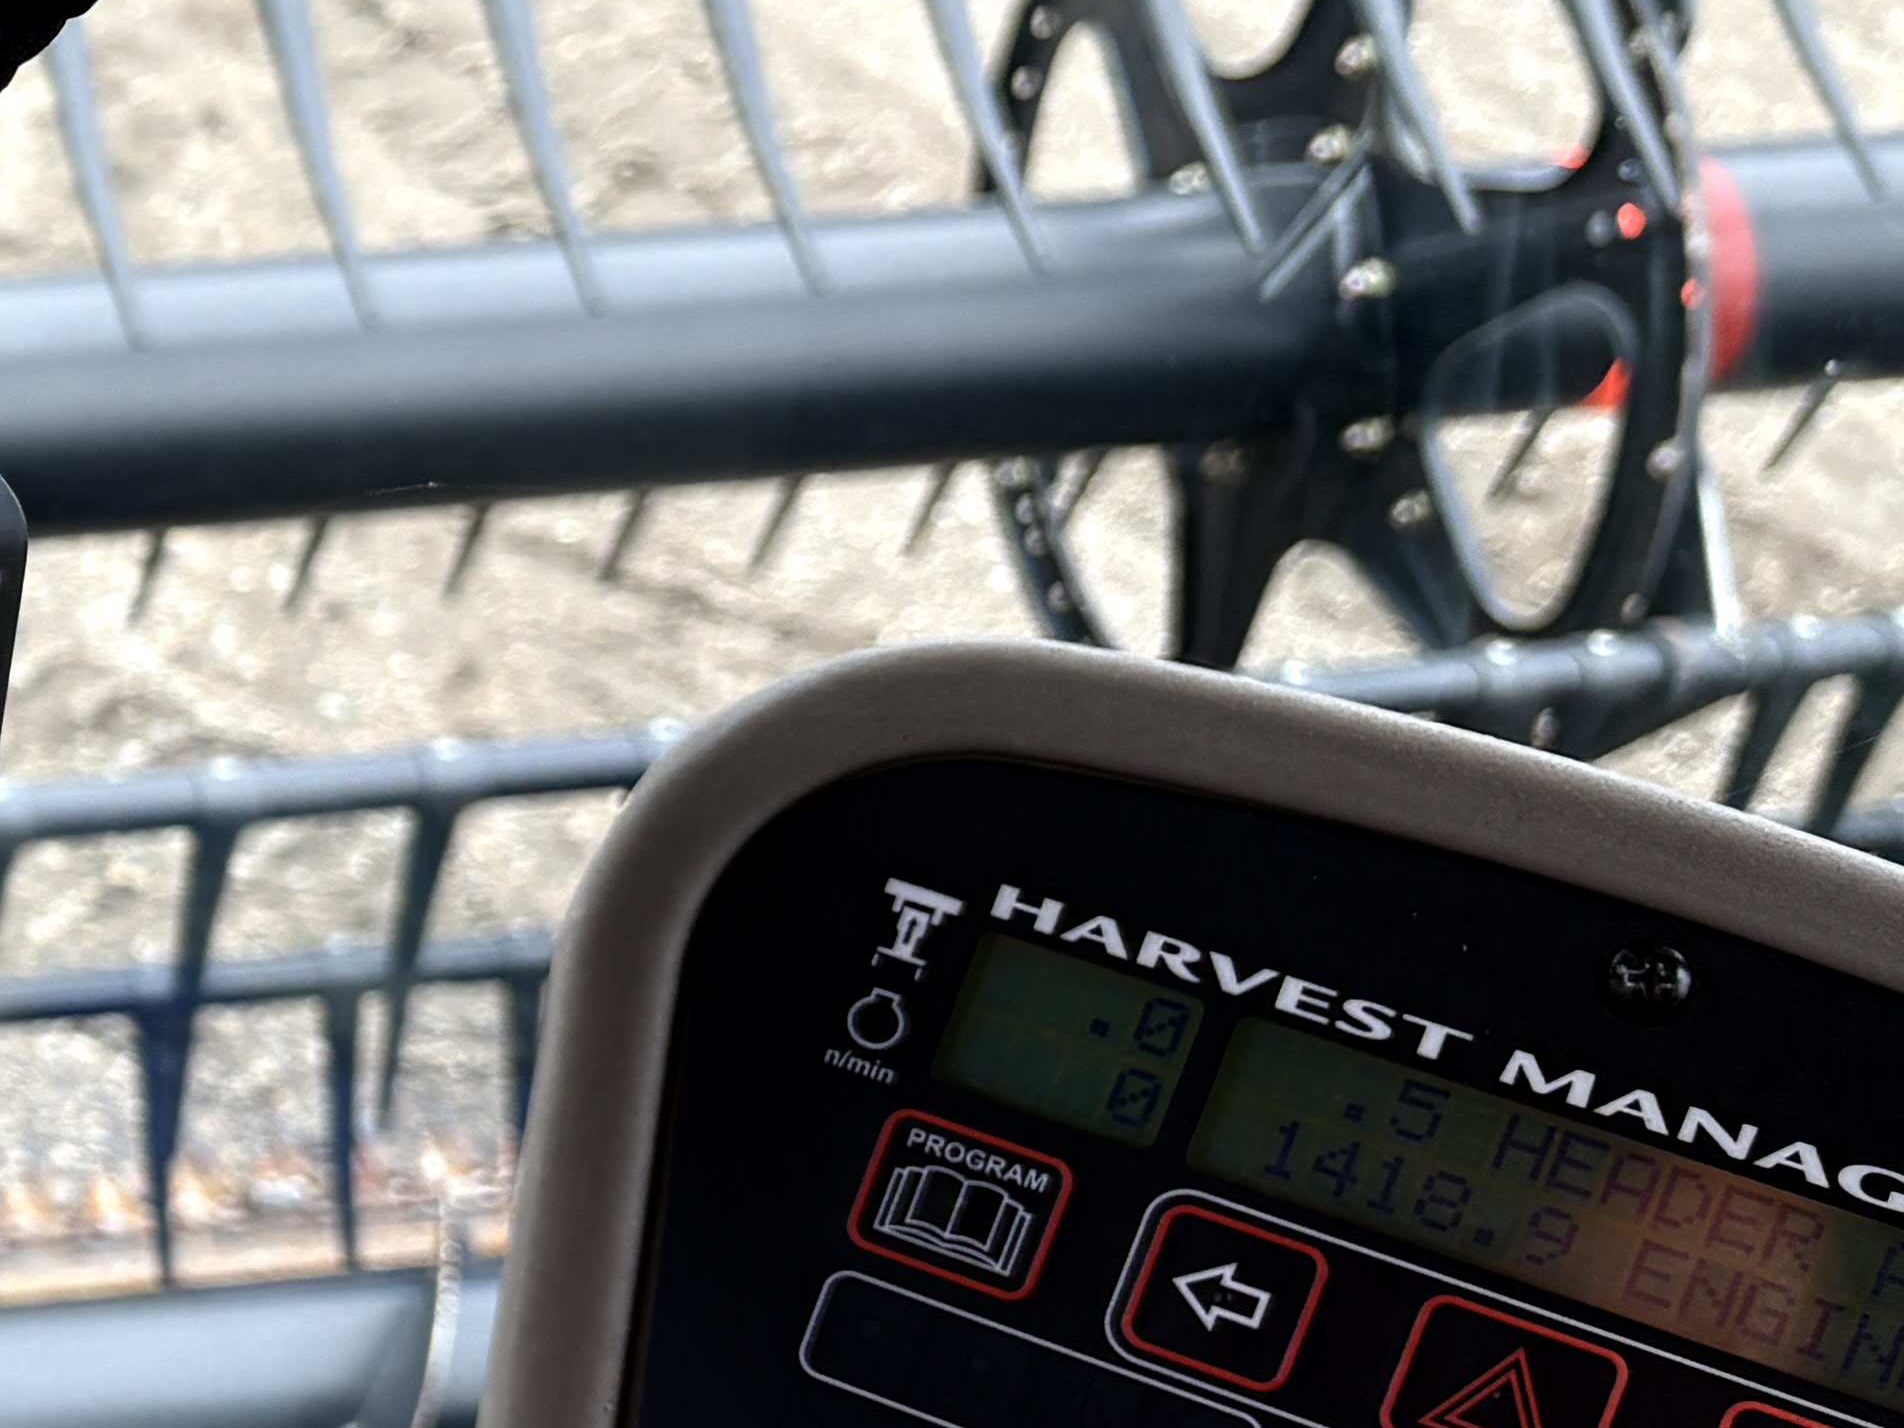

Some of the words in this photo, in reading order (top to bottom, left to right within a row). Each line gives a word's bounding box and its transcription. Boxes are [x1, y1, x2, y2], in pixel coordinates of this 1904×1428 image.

[991, 884, 1473, 1062] HARVEST
[823, 1045, 897, 1087] n/min
[906, 1127, 1052, 1196] PROGRAM
[1493, 1111, 1827, 1277] HEADER
[1622, 1239, 1904, 1396] ENGIN
